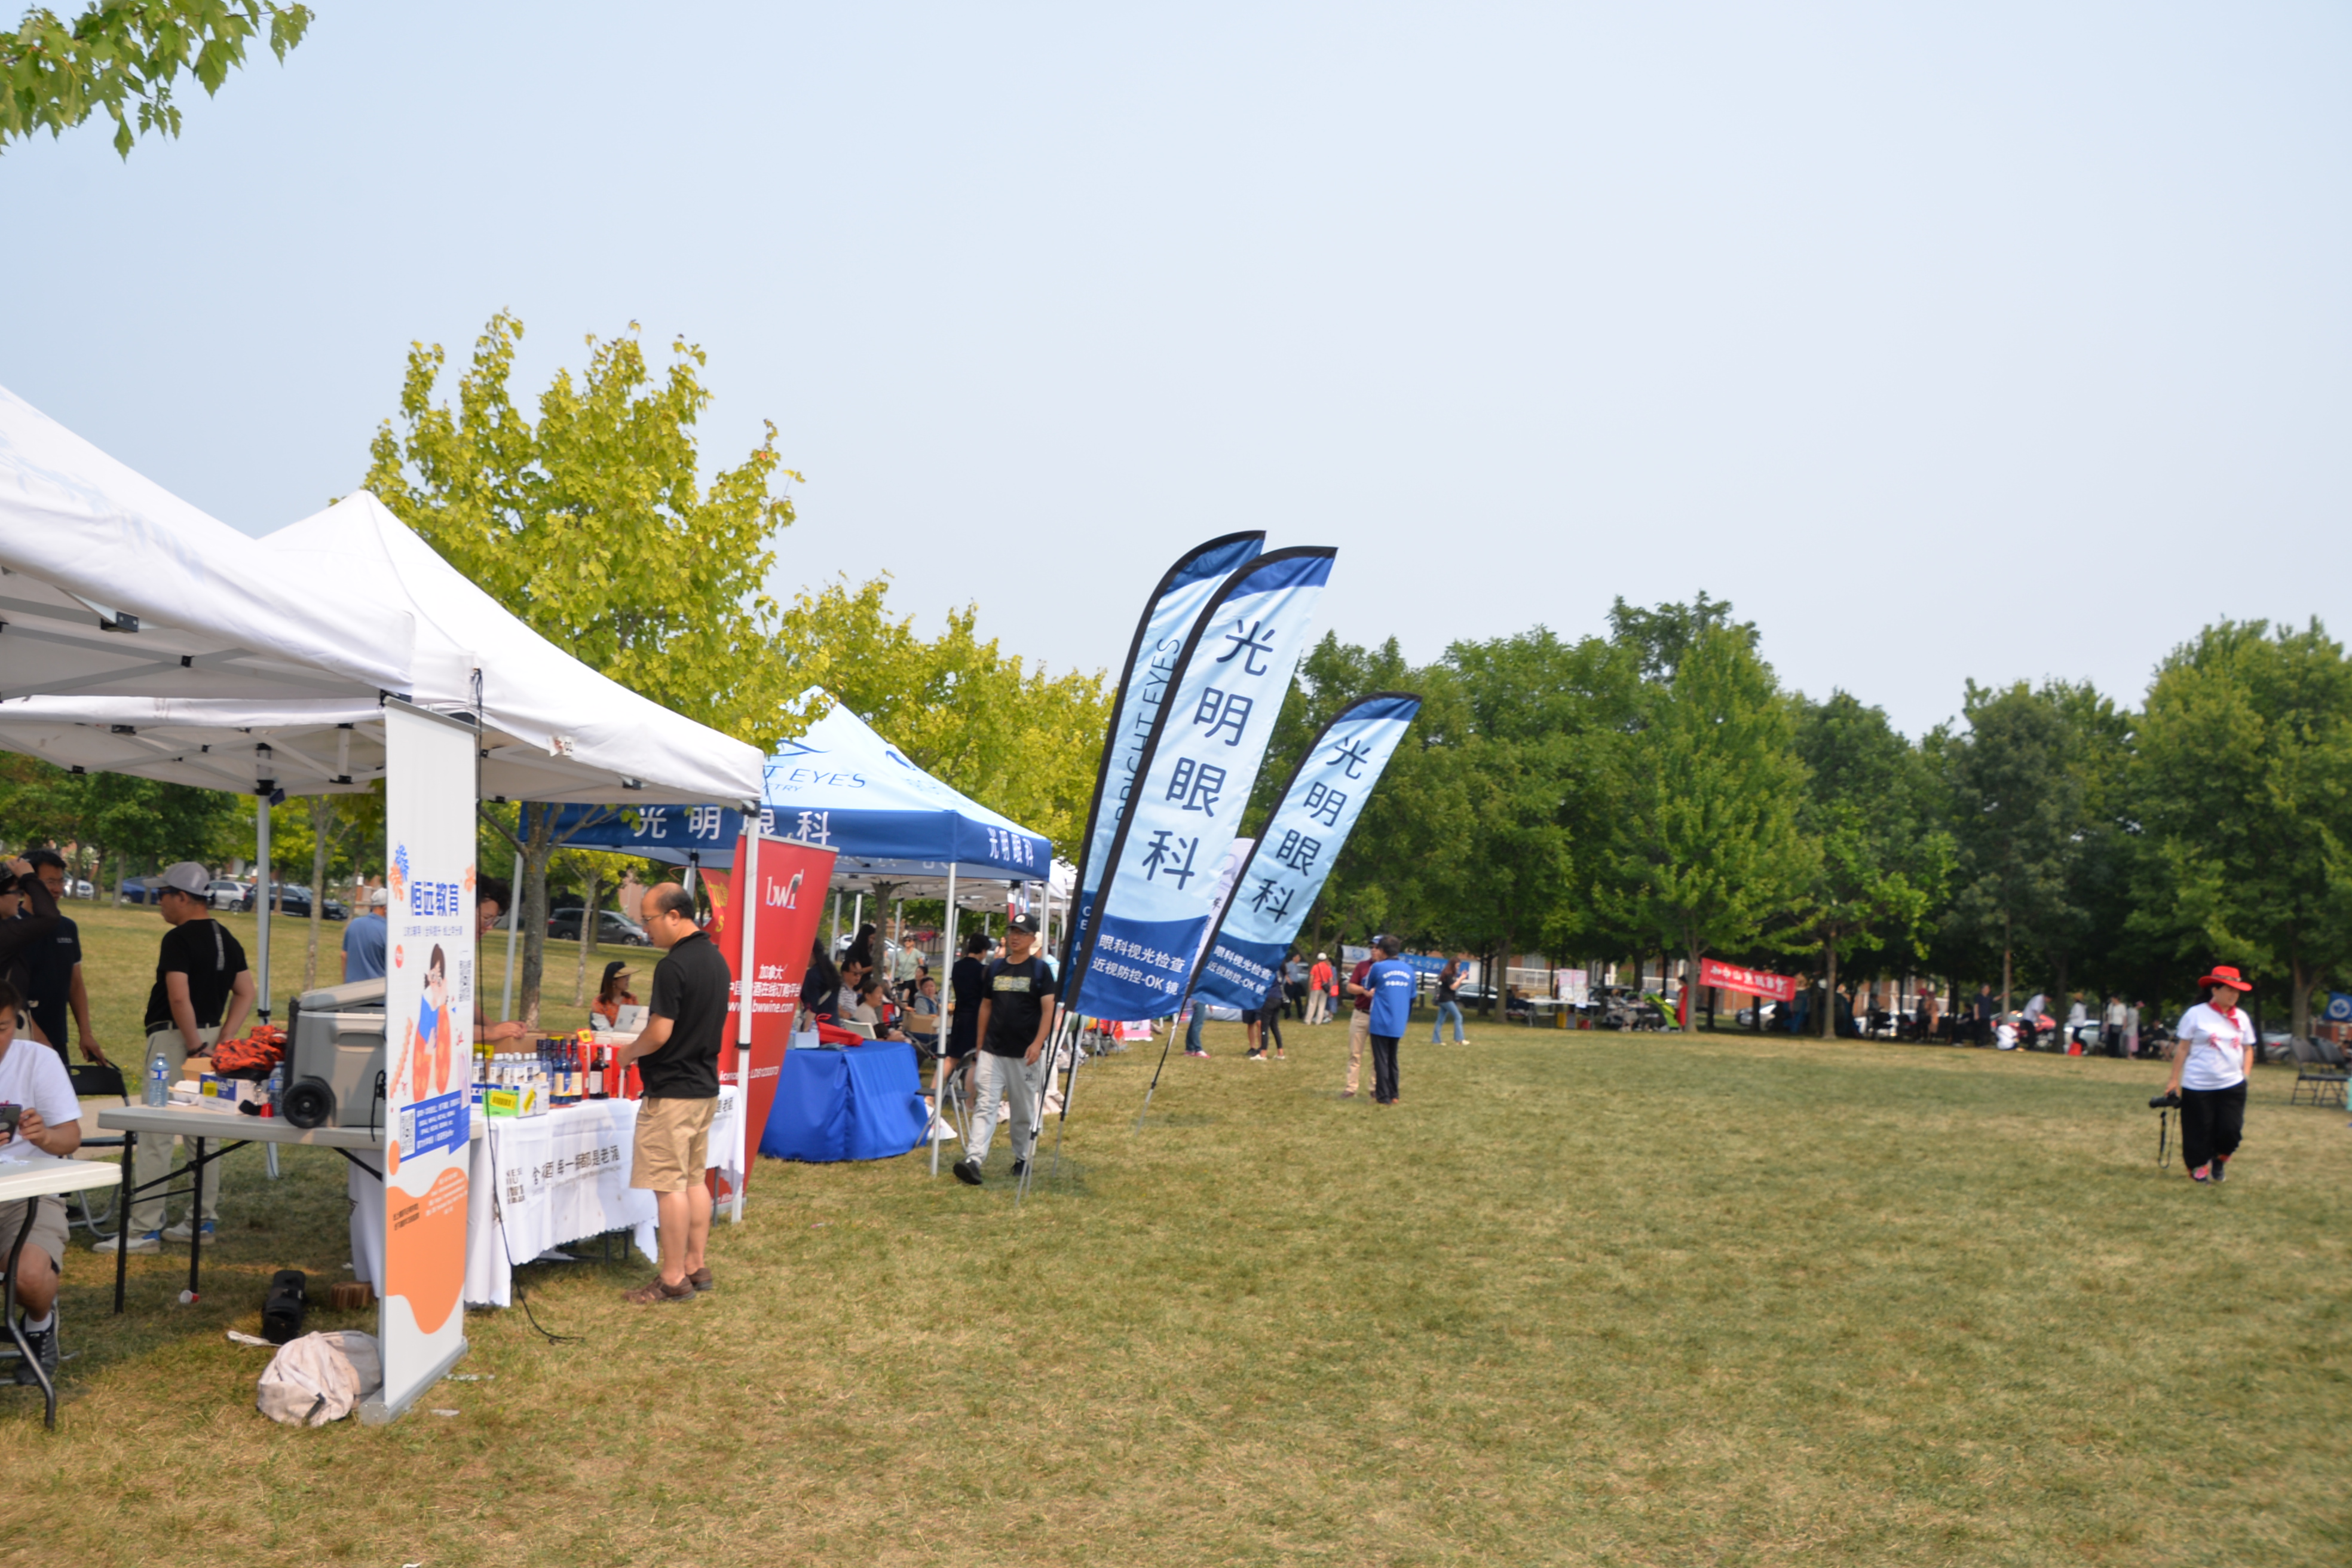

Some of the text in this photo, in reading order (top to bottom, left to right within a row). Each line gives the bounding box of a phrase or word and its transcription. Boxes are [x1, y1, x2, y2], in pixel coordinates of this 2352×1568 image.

[1143, 638, 1180, 705] EYES
[1142, 619, 1275, 890] 光明眼科
[789, 768, 866, 788] EYES
[987, 827, 1034, 868] 光明眼科
[1252, 737, 1371, 923] 光明眼科
[411, 881, 459, 917] 恒远教育
[758, 964, 784, 980] 加拿大
[1098, 934, 1186, 973] 眼科视光检查
[1091, 957, 1165, 991] 近视防控-OK
